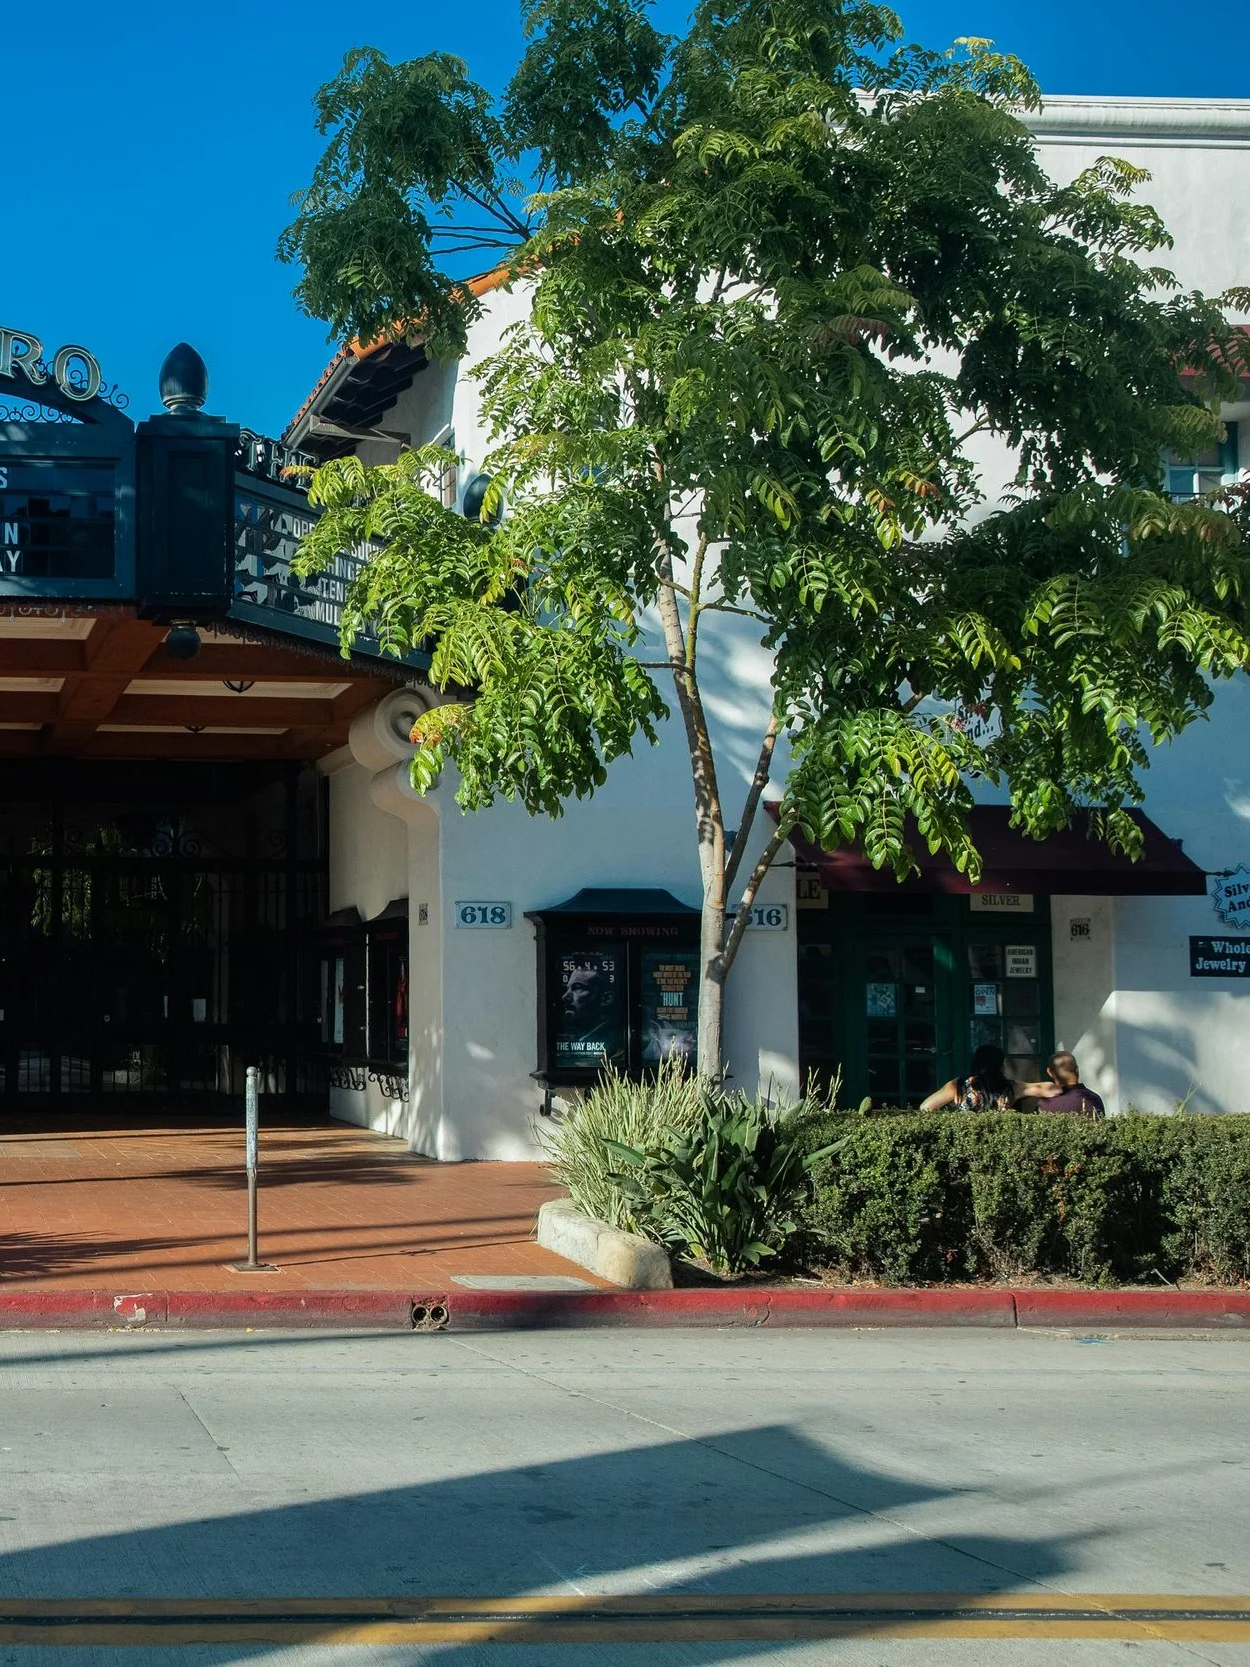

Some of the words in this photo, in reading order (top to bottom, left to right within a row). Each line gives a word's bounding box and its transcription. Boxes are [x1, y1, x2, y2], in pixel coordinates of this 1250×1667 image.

[321, 577, 347, 602] TEN
[315, 600, 341, 626] MUL
[981, 894, 1021, 906] SILVER
[460, 905, 506, 924] 618
[587, 926, 615, 936] NOW
[620, 926, 678, 936] SHOWING
[1070, 923, 1090, 936] 616
[1196, 957, 1247, 973] Jewelry
[556, 1042, 569, 1050] THE
[570, 1042, 585, 1050] WAY
[586, 1042, 605, 1051] BACK
